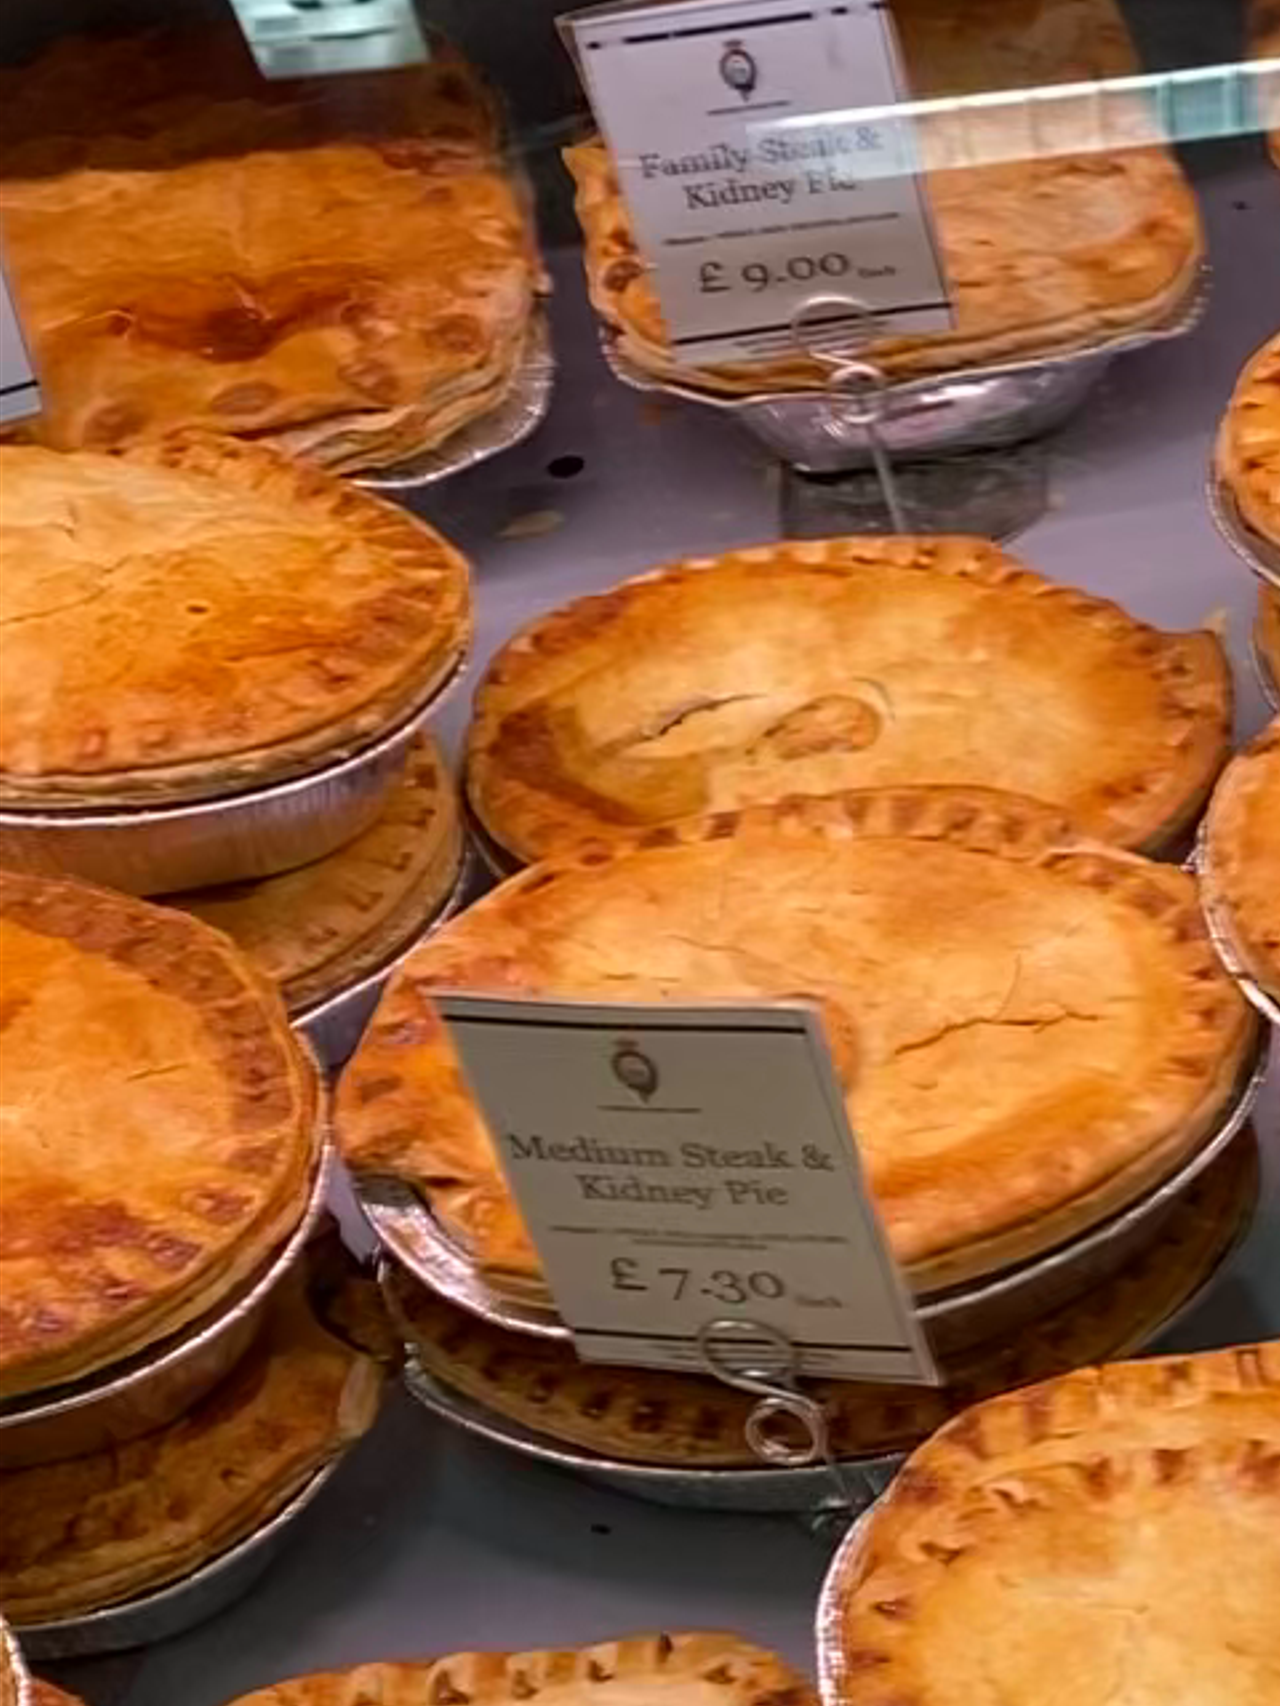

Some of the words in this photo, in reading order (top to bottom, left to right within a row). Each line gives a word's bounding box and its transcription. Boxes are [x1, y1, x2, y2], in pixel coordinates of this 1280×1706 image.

[639, 143, 749, 180] Family
[757, 132, 852, 165] Steak
[856, 125, 886, 150] &
[682, 175, 796, 210] Kidney
[508, 1133, 672, 1168] Medium
[679, 1142, 794, 1172] Steak
[799, 1143, 836, 1172] &
[575, 1173, 713, 1211] Kidney
[724, 1178, 790, 1206] Pie
